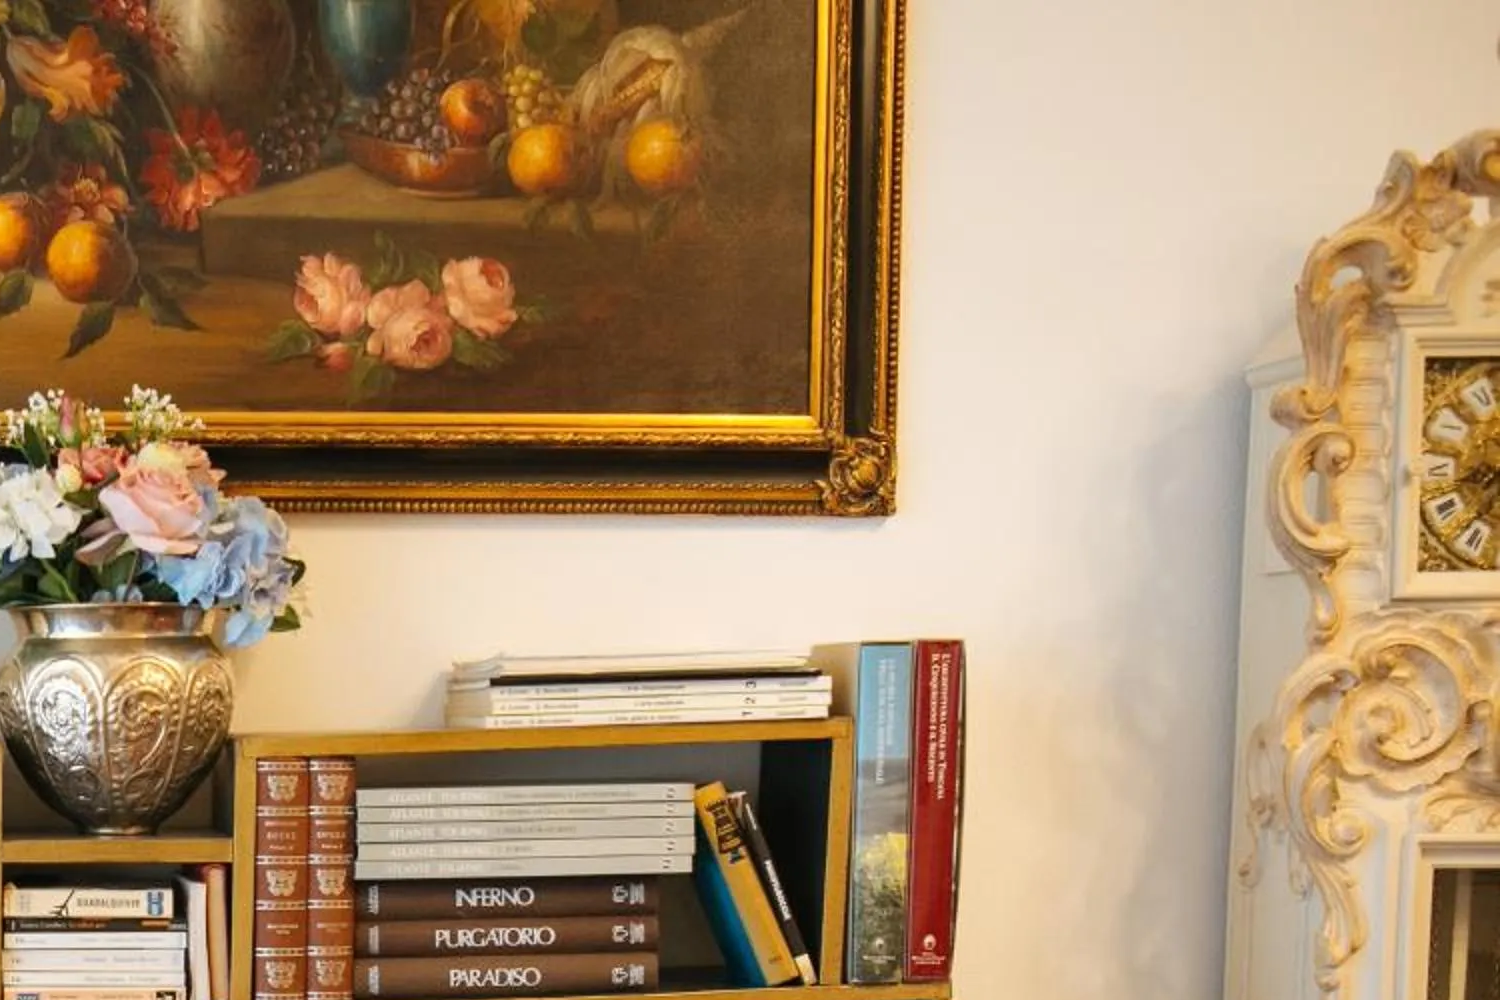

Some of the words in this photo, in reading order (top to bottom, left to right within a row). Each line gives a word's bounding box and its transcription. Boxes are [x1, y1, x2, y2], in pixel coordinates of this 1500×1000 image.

[455, 887, 535, 907] INFERNO
[435, 926, 556, 948] PURGATORIO
[450, 967, 542, 987] PARADISO
